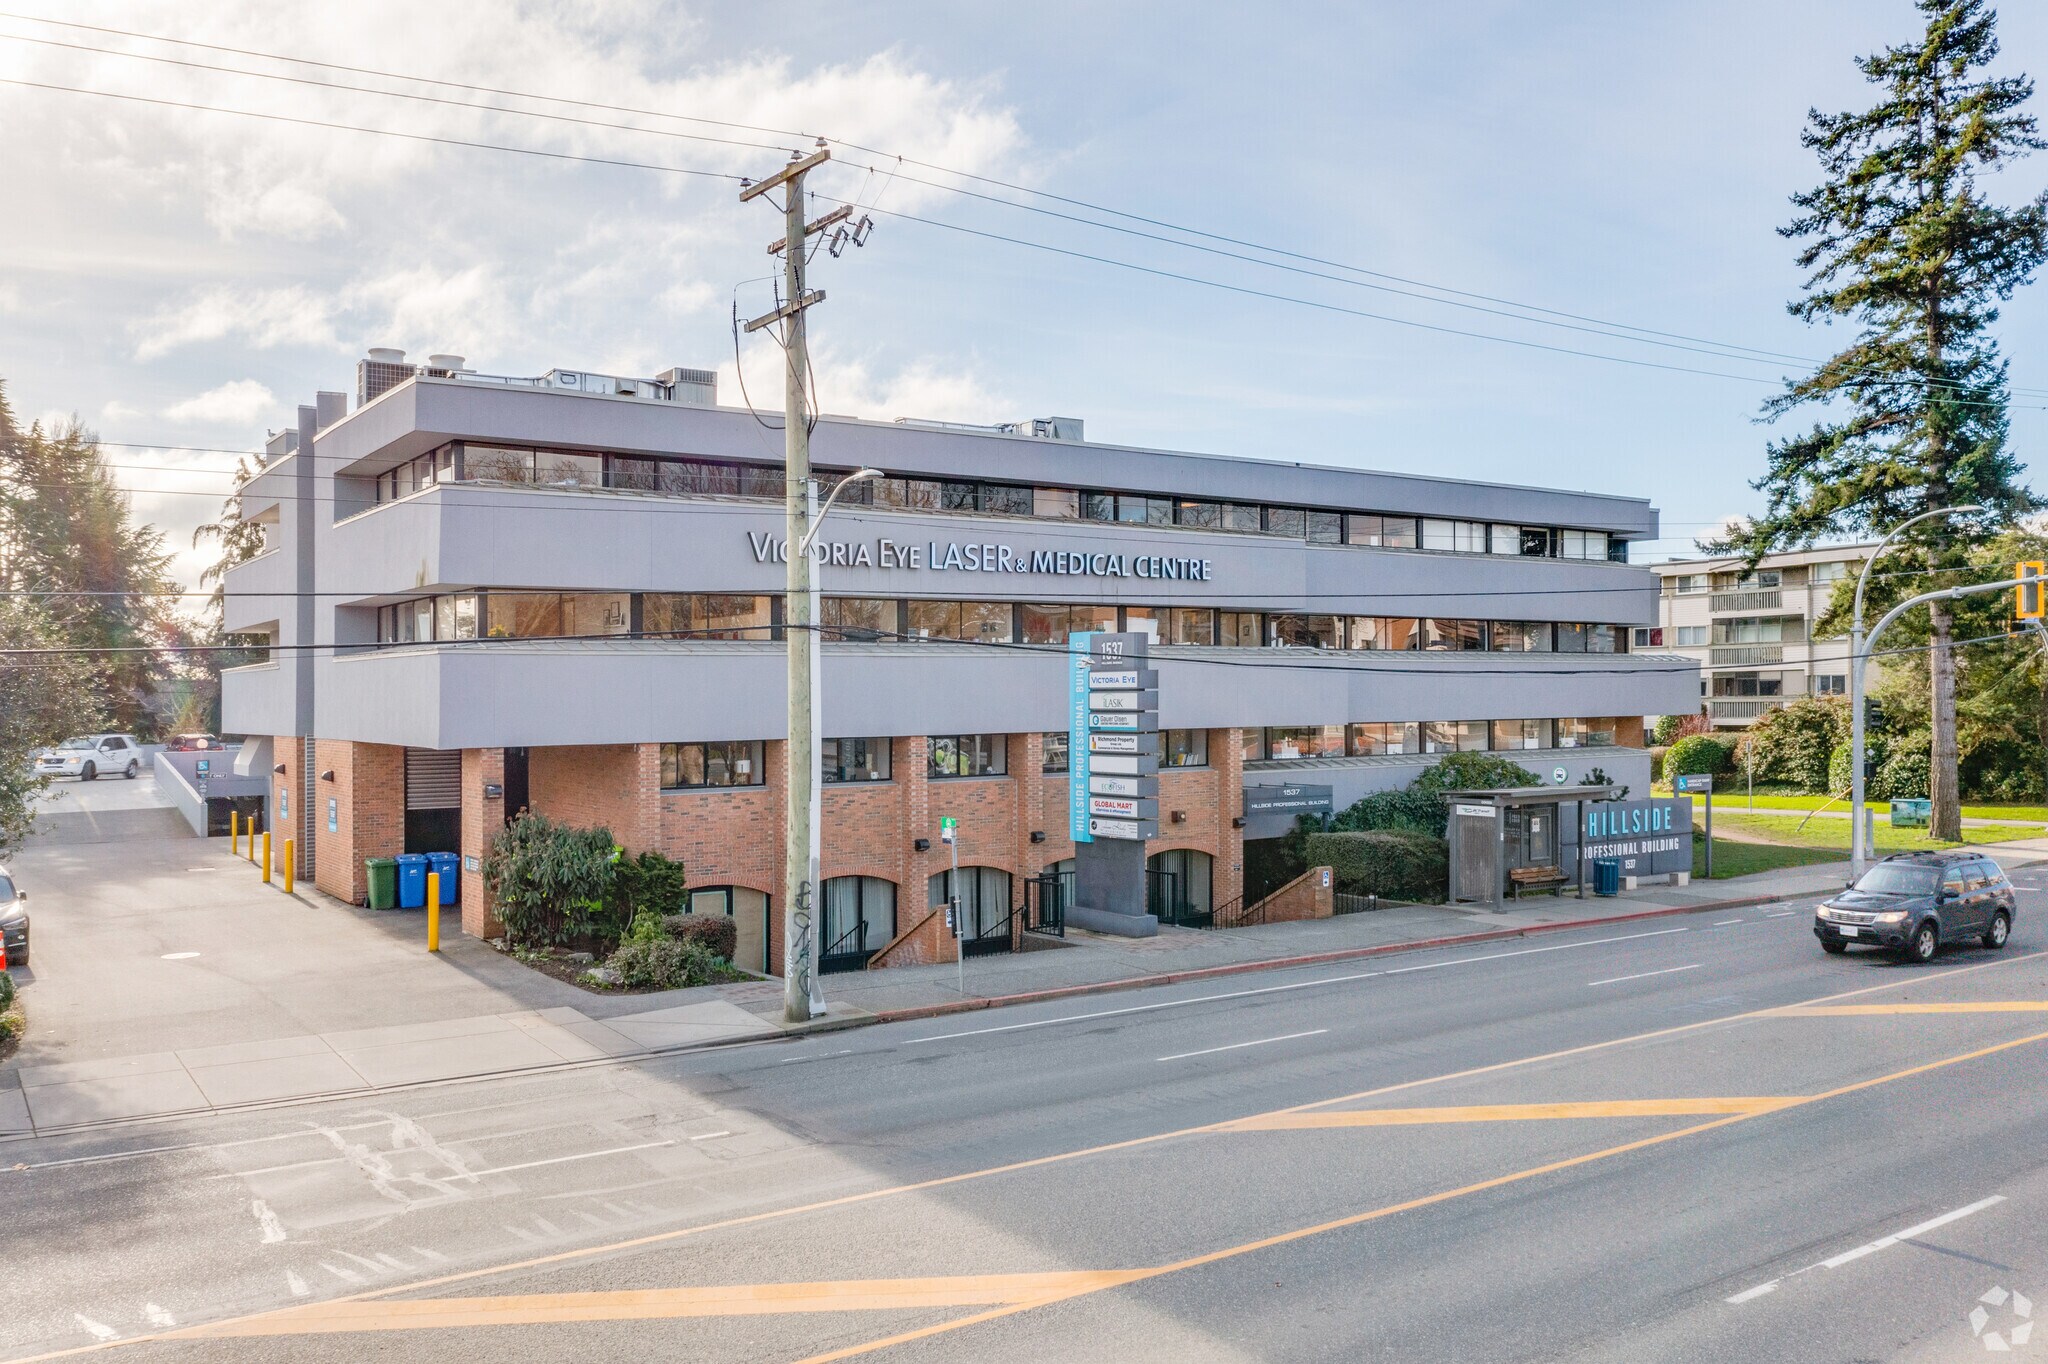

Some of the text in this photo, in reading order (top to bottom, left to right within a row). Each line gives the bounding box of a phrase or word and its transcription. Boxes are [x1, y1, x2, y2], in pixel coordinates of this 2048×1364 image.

[748, 532, 872, 567] VICORIA
[929, 541, 1013, 573] LASER
[1015, 557, 1028, 573] &
[1031, 549, 1131, 578] MEDICAL
[1133, 555, 1212, 581] CENTRE
[1101, 641, 1123, 660] 1537
[1091, 675, 1136, 684] VICTORIA EYE
[1075, 699, 1084, 779] PROFESSIONAL
[1283, 788, 1301, 796] 1537
[1075, 783, 1084, 831] HILLSIDE
[1094, 800, 1133, 810] GLOBAL MART
[1588, 806, 1672, 837] HILLSIDE
[1576, 838, 1679, 860] ROFESSIONAL BUILDING
[1624, 859, 1636, 869] 1537
